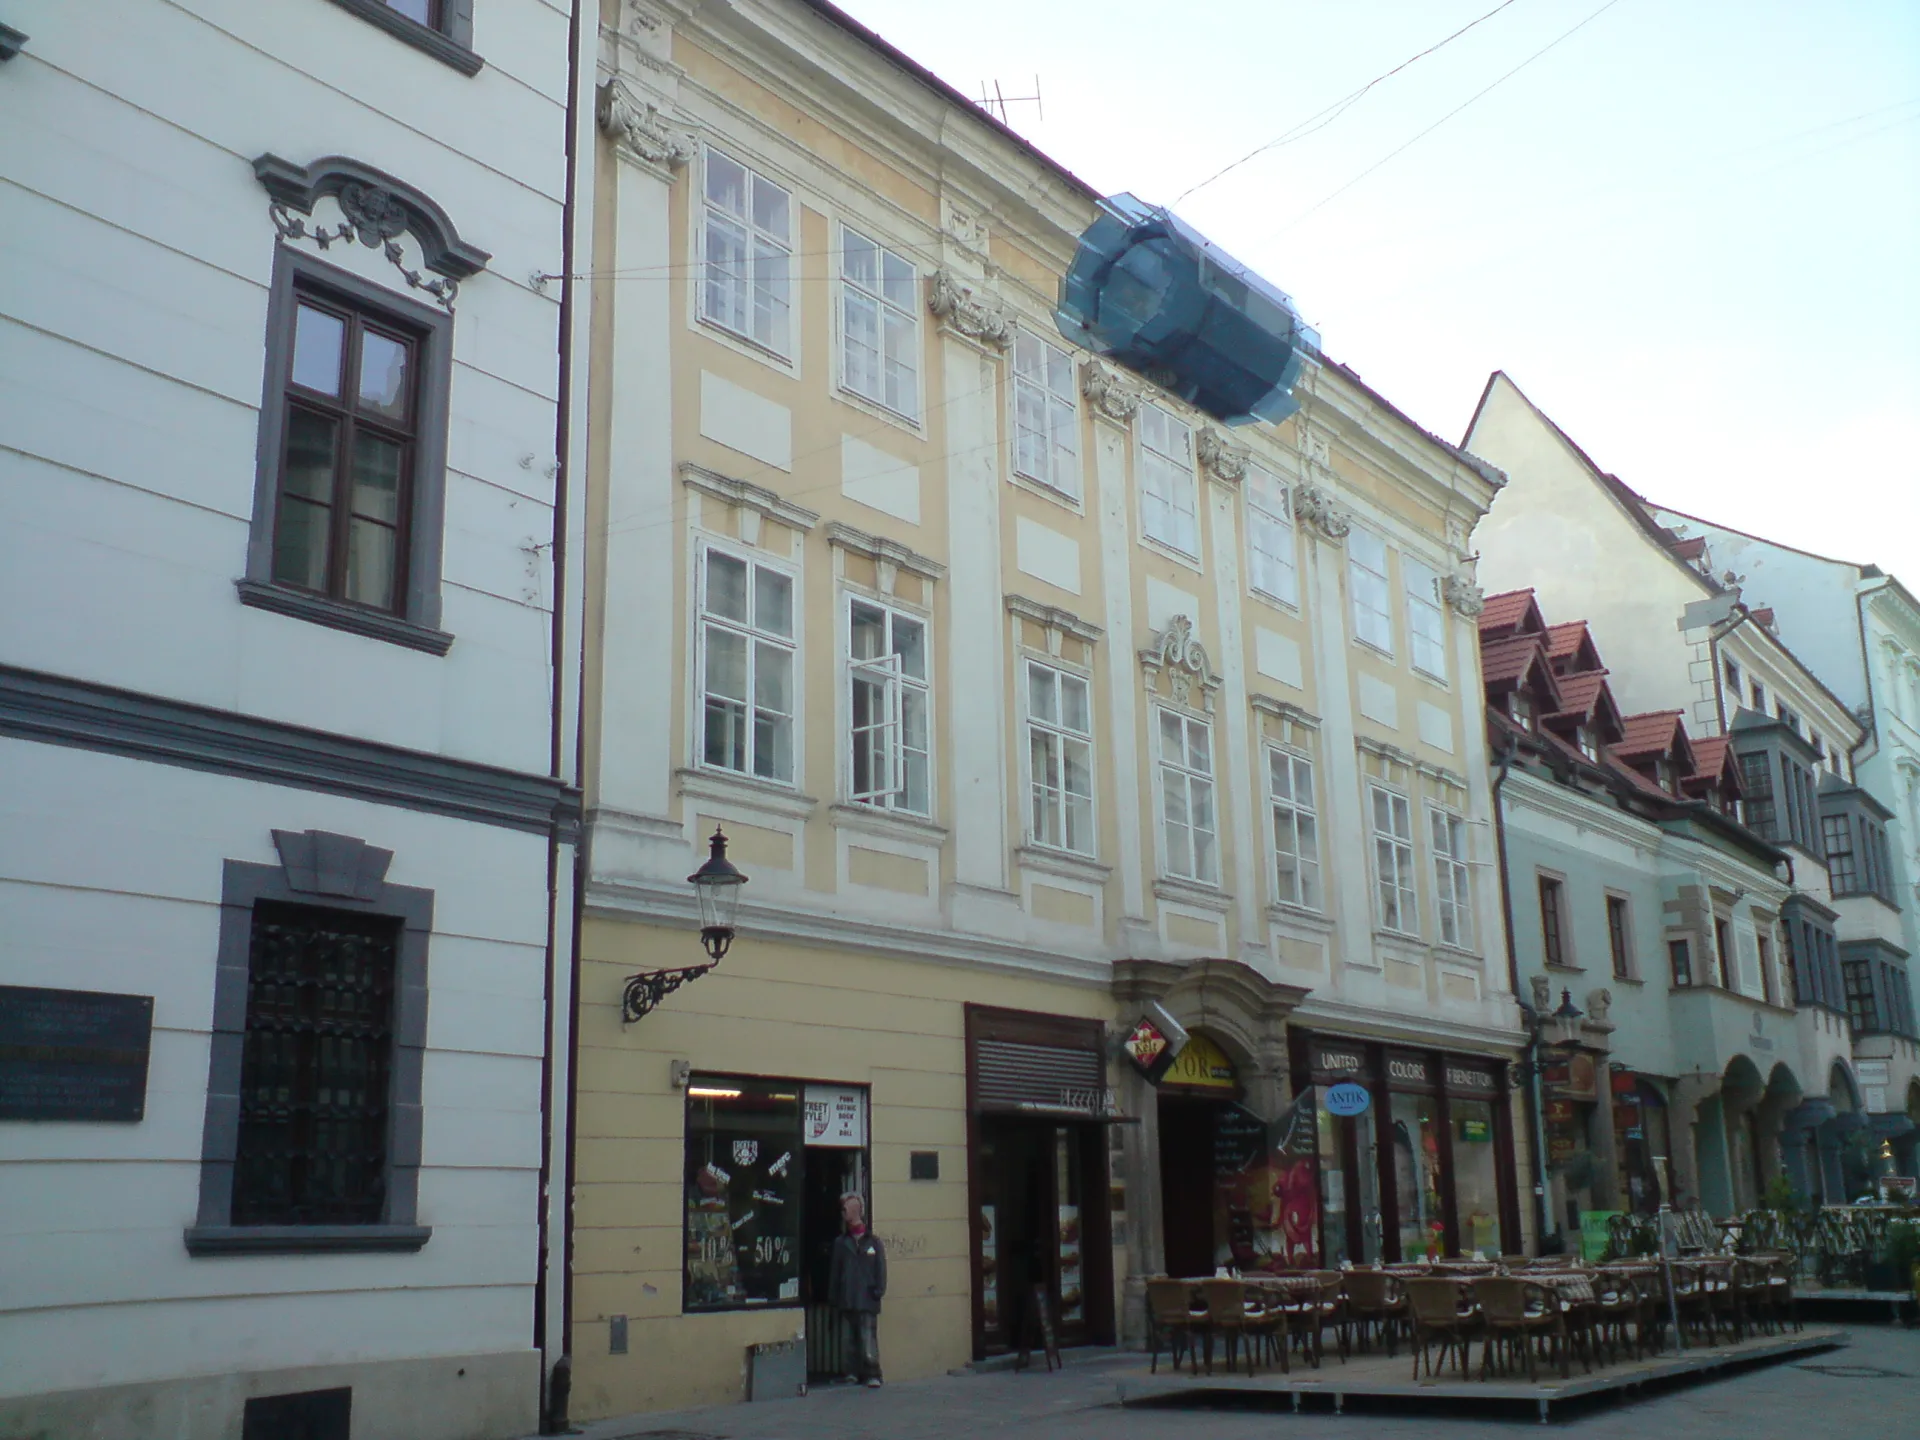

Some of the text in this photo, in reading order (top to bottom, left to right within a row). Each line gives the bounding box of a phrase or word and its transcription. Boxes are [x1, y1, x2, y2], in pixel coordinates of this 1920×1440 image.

[1321, 1053, 1359, 1072] UNITED
[1389, 1060, 1425, 1080] COLORS
[1453, 1068, 1492, 1087] BENETTON
[1330, 1090, 1365, 1104] ANTIK
[805, 1102, 828, 1113] TREET
[805, 1111, 823, 1121] TYLE
[755, 1236, 790, 1265] 50%
